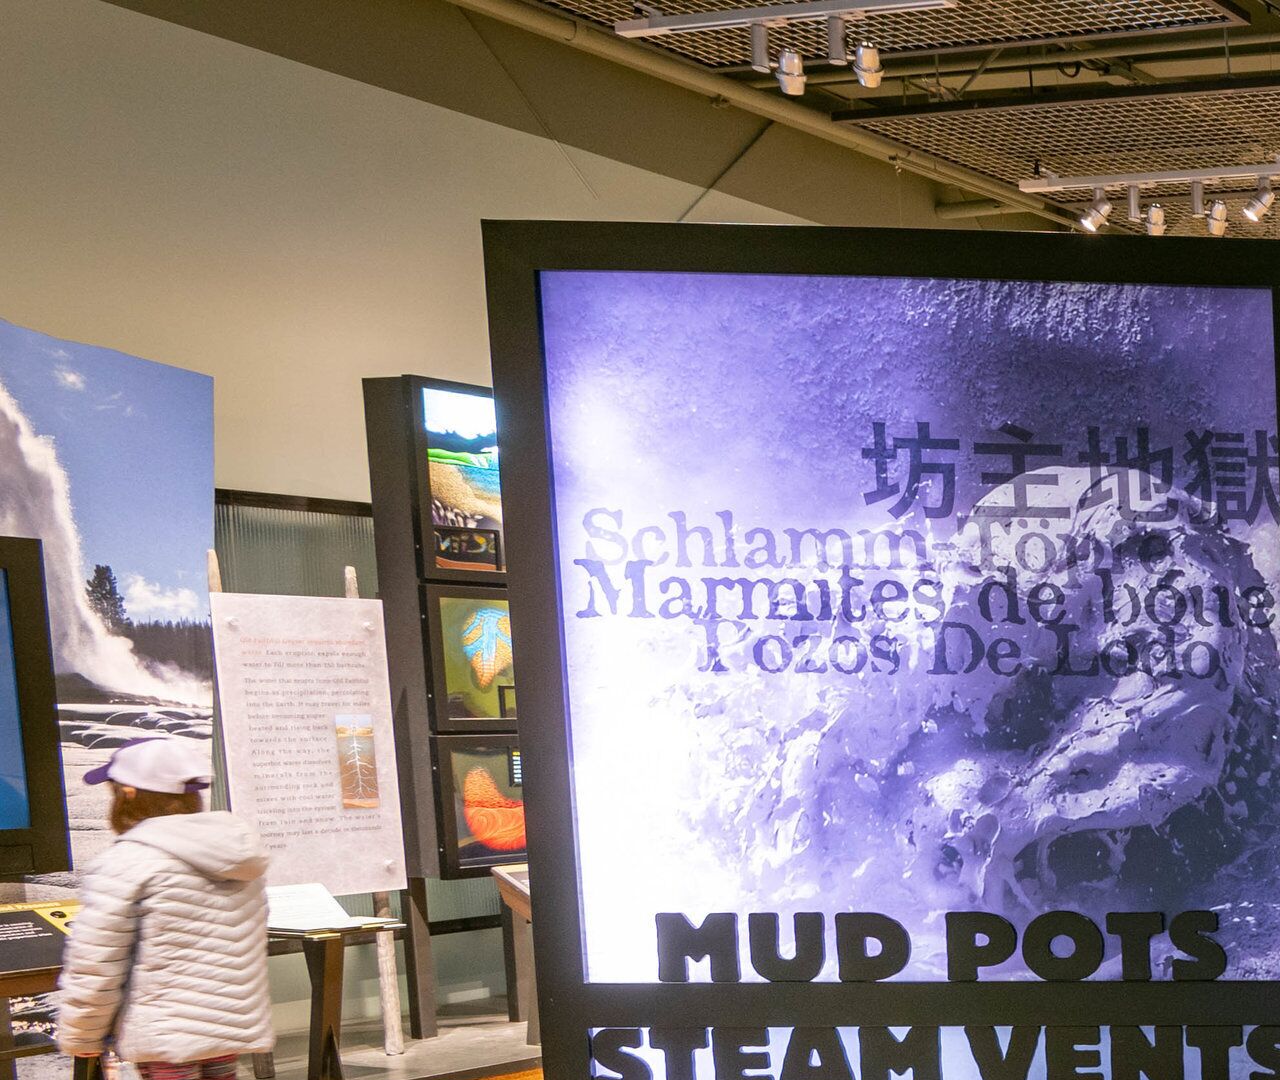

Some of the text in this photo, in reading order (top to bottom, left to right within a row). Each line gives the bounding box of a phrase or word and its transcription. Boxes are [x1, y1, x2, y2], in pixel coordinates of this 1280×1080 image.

[574, 559, 946, 623] Marmites
[978, 566, 1066, 625] de
[925, 622, 1021, 677] De
[656, 911, 1229, 983] MUD POTS
